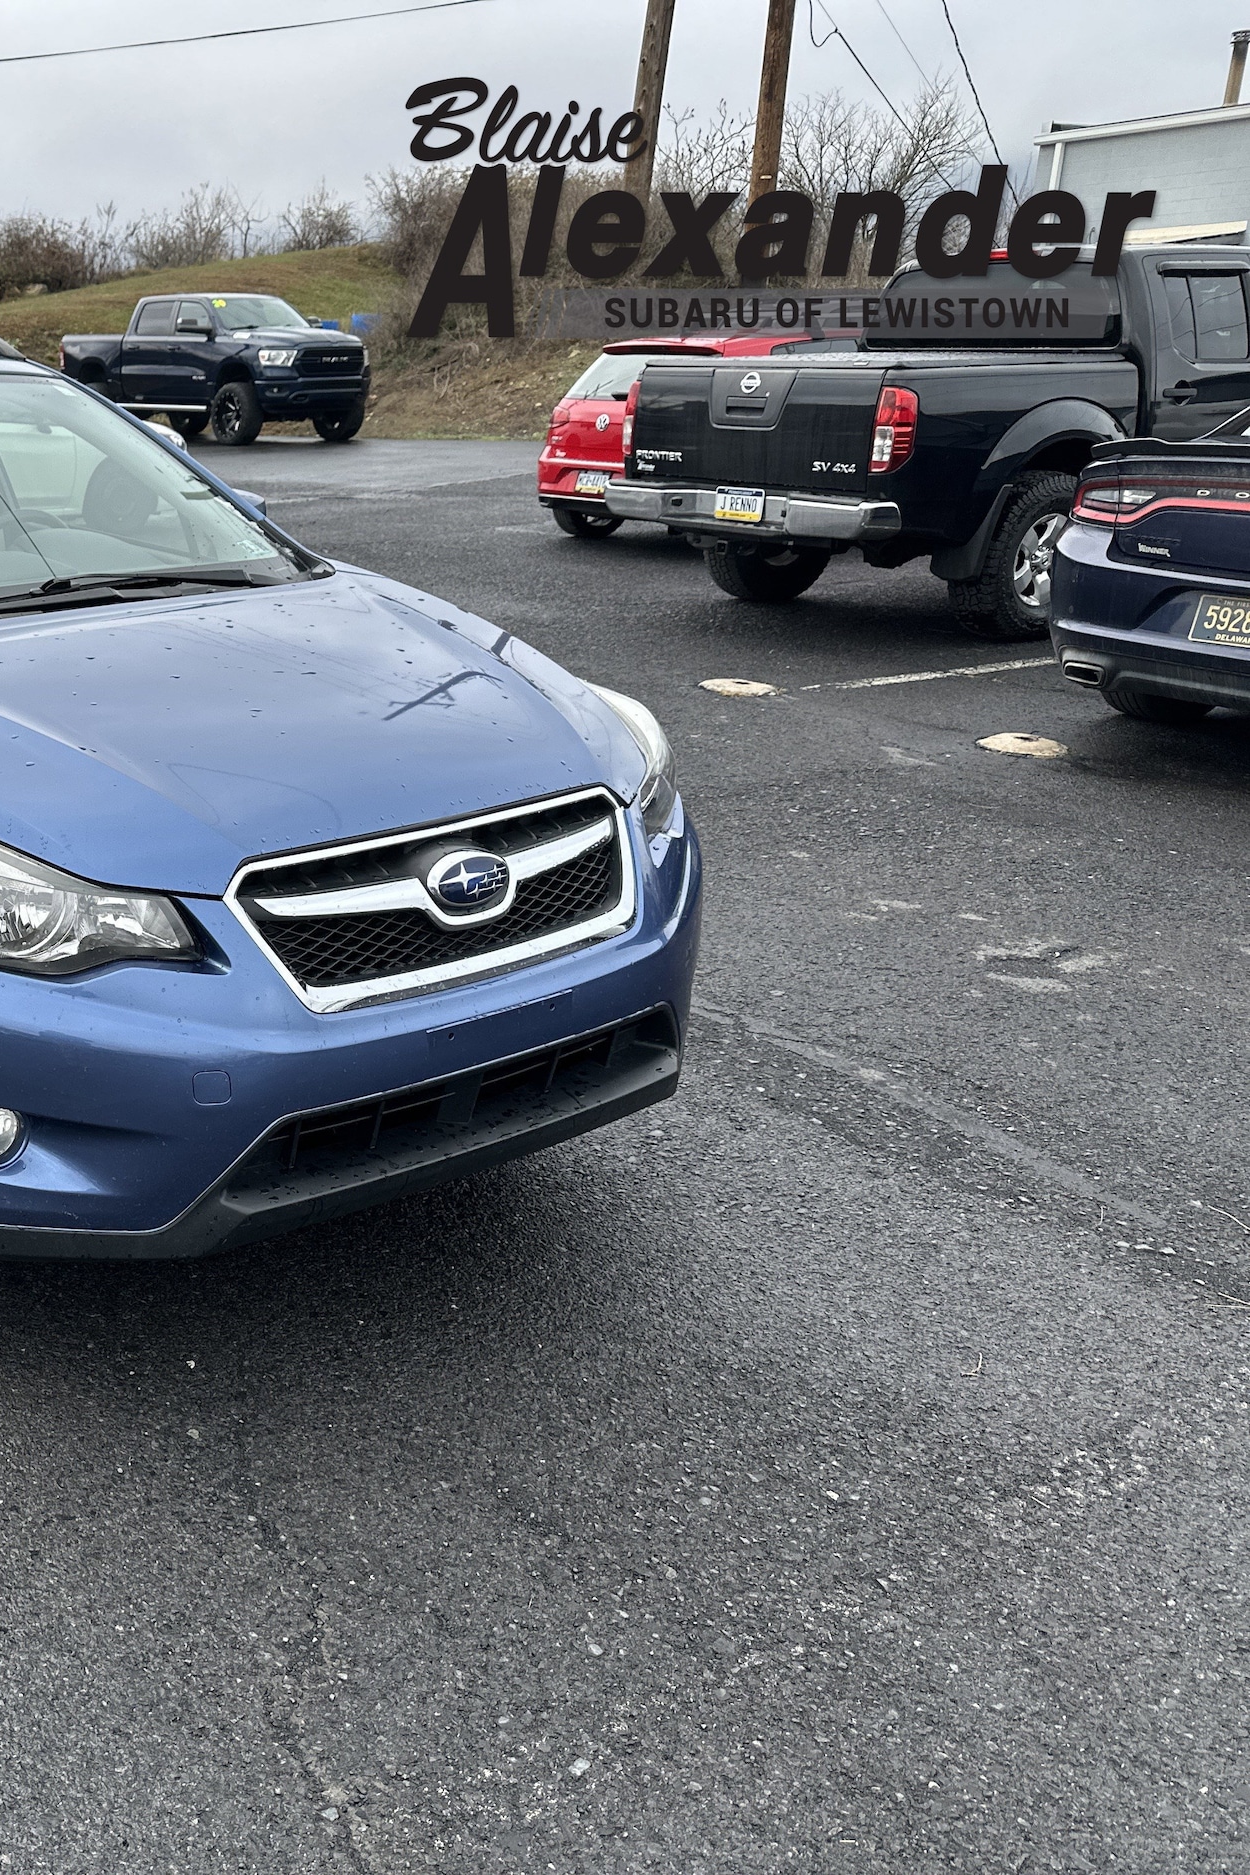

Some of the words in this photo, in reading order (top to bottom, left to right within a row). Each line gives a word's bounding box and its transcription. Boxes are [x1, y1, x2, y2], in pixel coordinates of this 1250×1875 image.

[635, 449, 682, 462] FRONTIER
[811, 461, 831, 472] SV
[720, 496, 727, 510] J
[730, 496, 758, 513] RENNO
